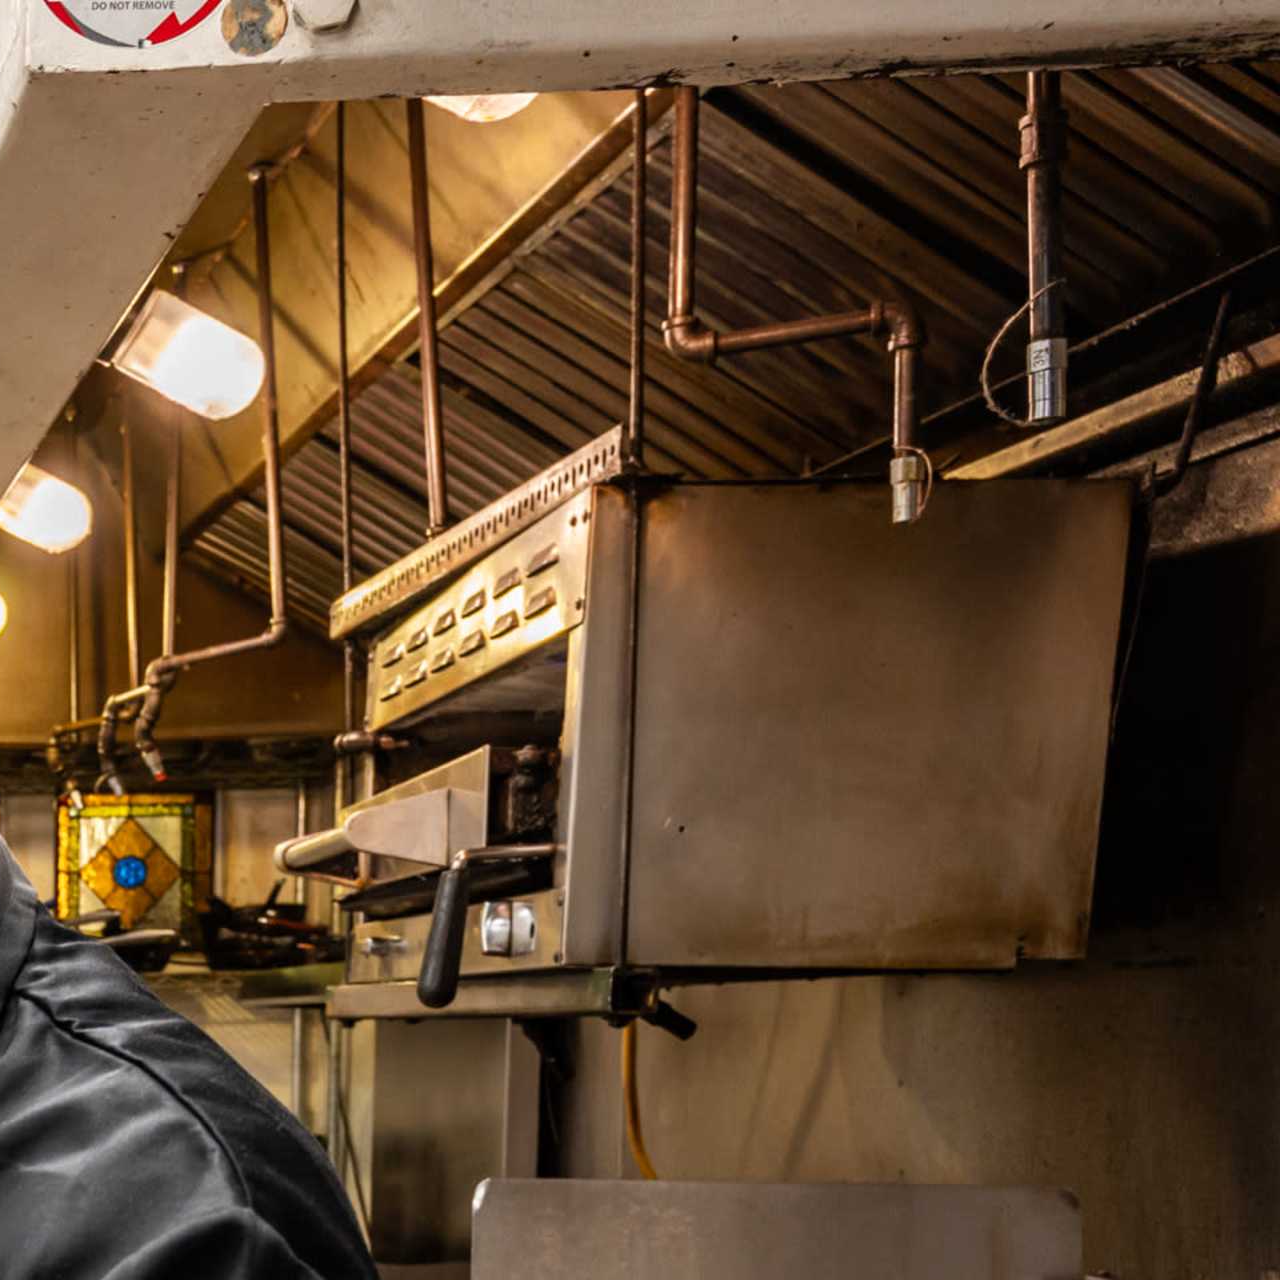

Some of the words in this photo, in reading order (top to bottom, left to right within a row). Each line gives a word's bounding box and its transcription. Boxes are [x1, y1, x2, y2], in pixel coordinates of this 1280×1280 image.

[91, 1, 108, 11] DO
[109, 1, 130, 11] NOT
[132, 0, 176, 10] REMOVE
